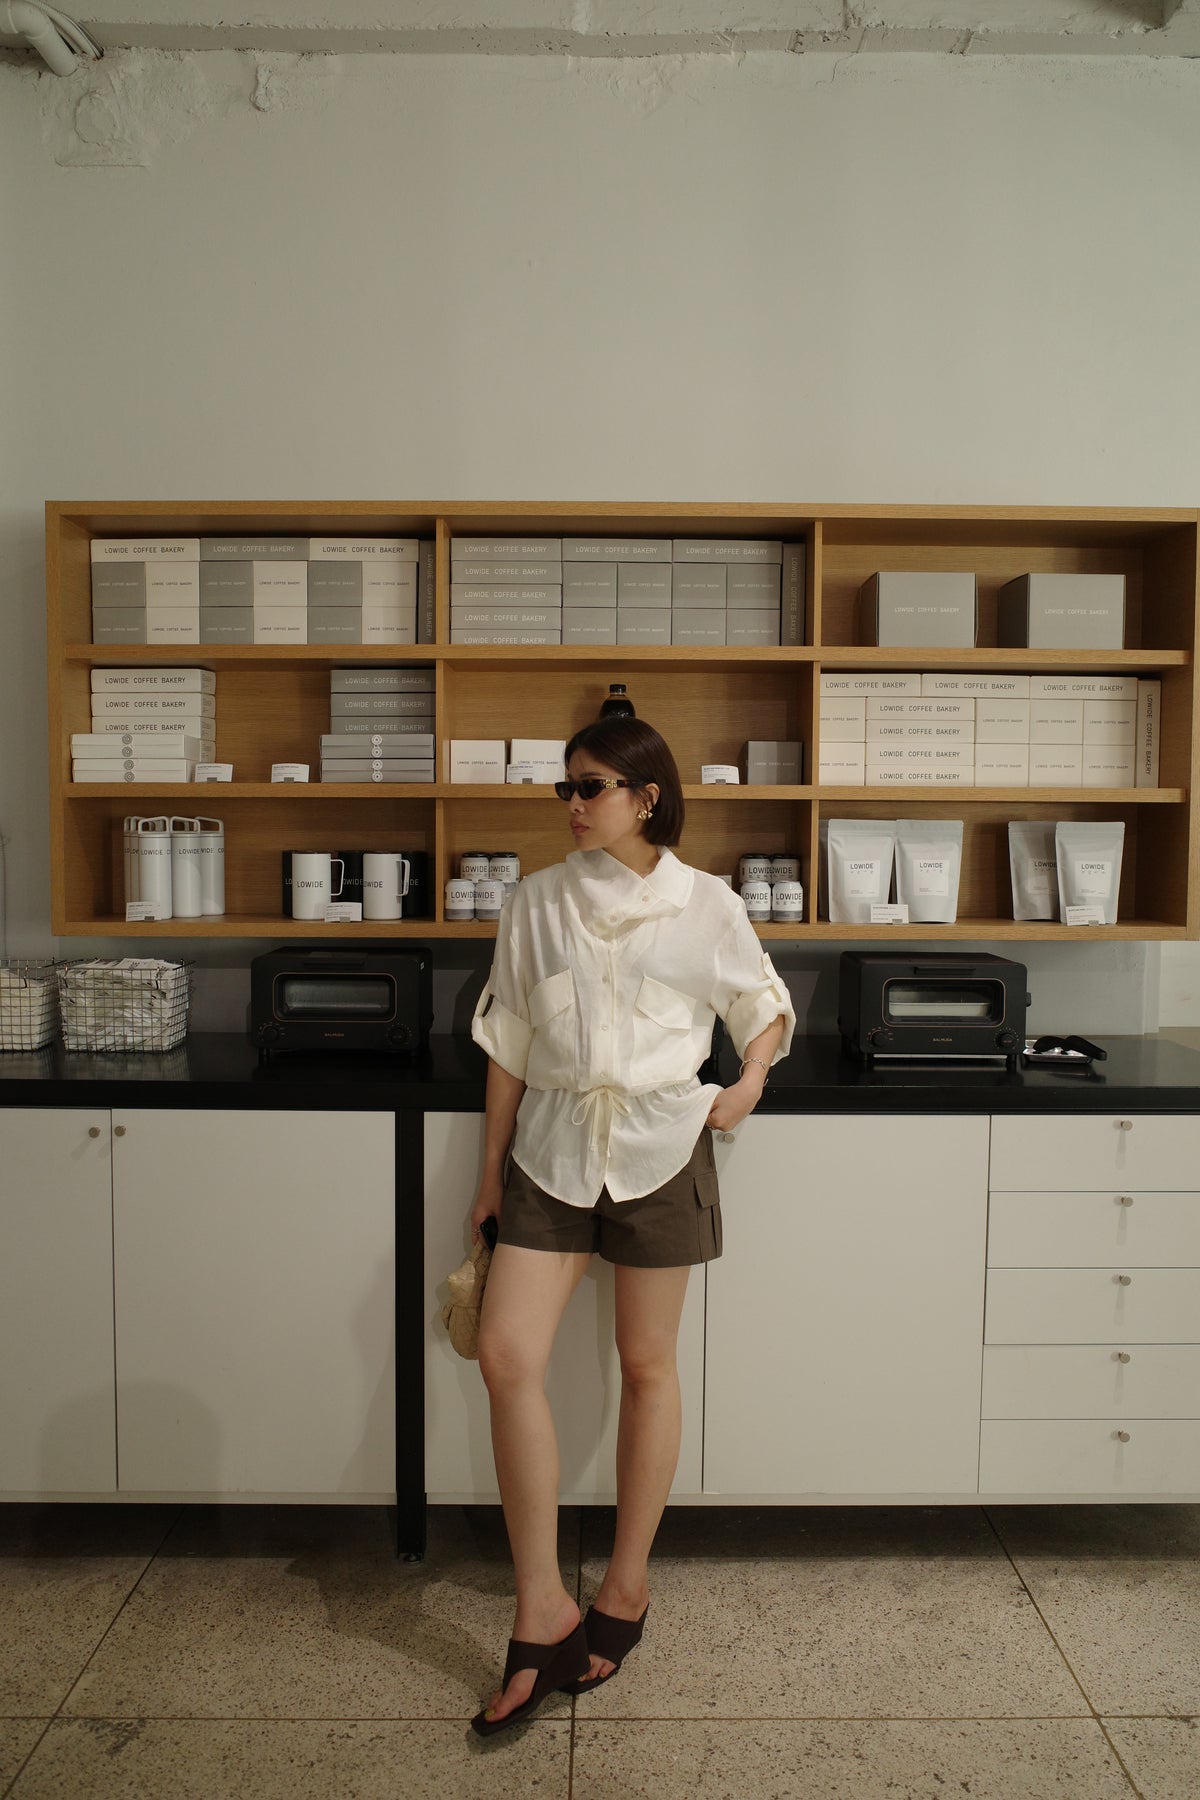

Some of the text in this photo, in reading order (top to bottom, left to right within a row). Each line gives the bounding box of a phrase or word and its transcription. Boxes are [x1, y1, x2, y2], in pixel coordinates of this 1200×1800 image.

[103, 546, 185, 554] LOWIDE COFFEE BAKERY
[212, 545, 296, 553] LOWIDE COFFEE BAKERY
[574, 546, 658, 554] LOWIDE COFFEE BAKERY
[685, 547, 768, 555] LOWIDE COFFEE BAKERY
[463, 591, 547, 599] LOWIDE COFFEE BAKERY
[463, 614, 547, 622] LOWIDE COFFEE BAKERY
[344, 677, 426, 685] LOWIDE COFFEE BAKERY
[824, 681, 907, 689] LOWIDE COFFEE BAKERY
[934, 682, 1016, 690] LOWIDE COFFEE BAKERY
[878, 750, 961, 758] LOWIDE COFFEE BAKERY
[462, 865, 488, 873] LOWIDE
[296, 880, 324, 888] LOWIDE
[776, 892, 802, 900] LOWIDE
